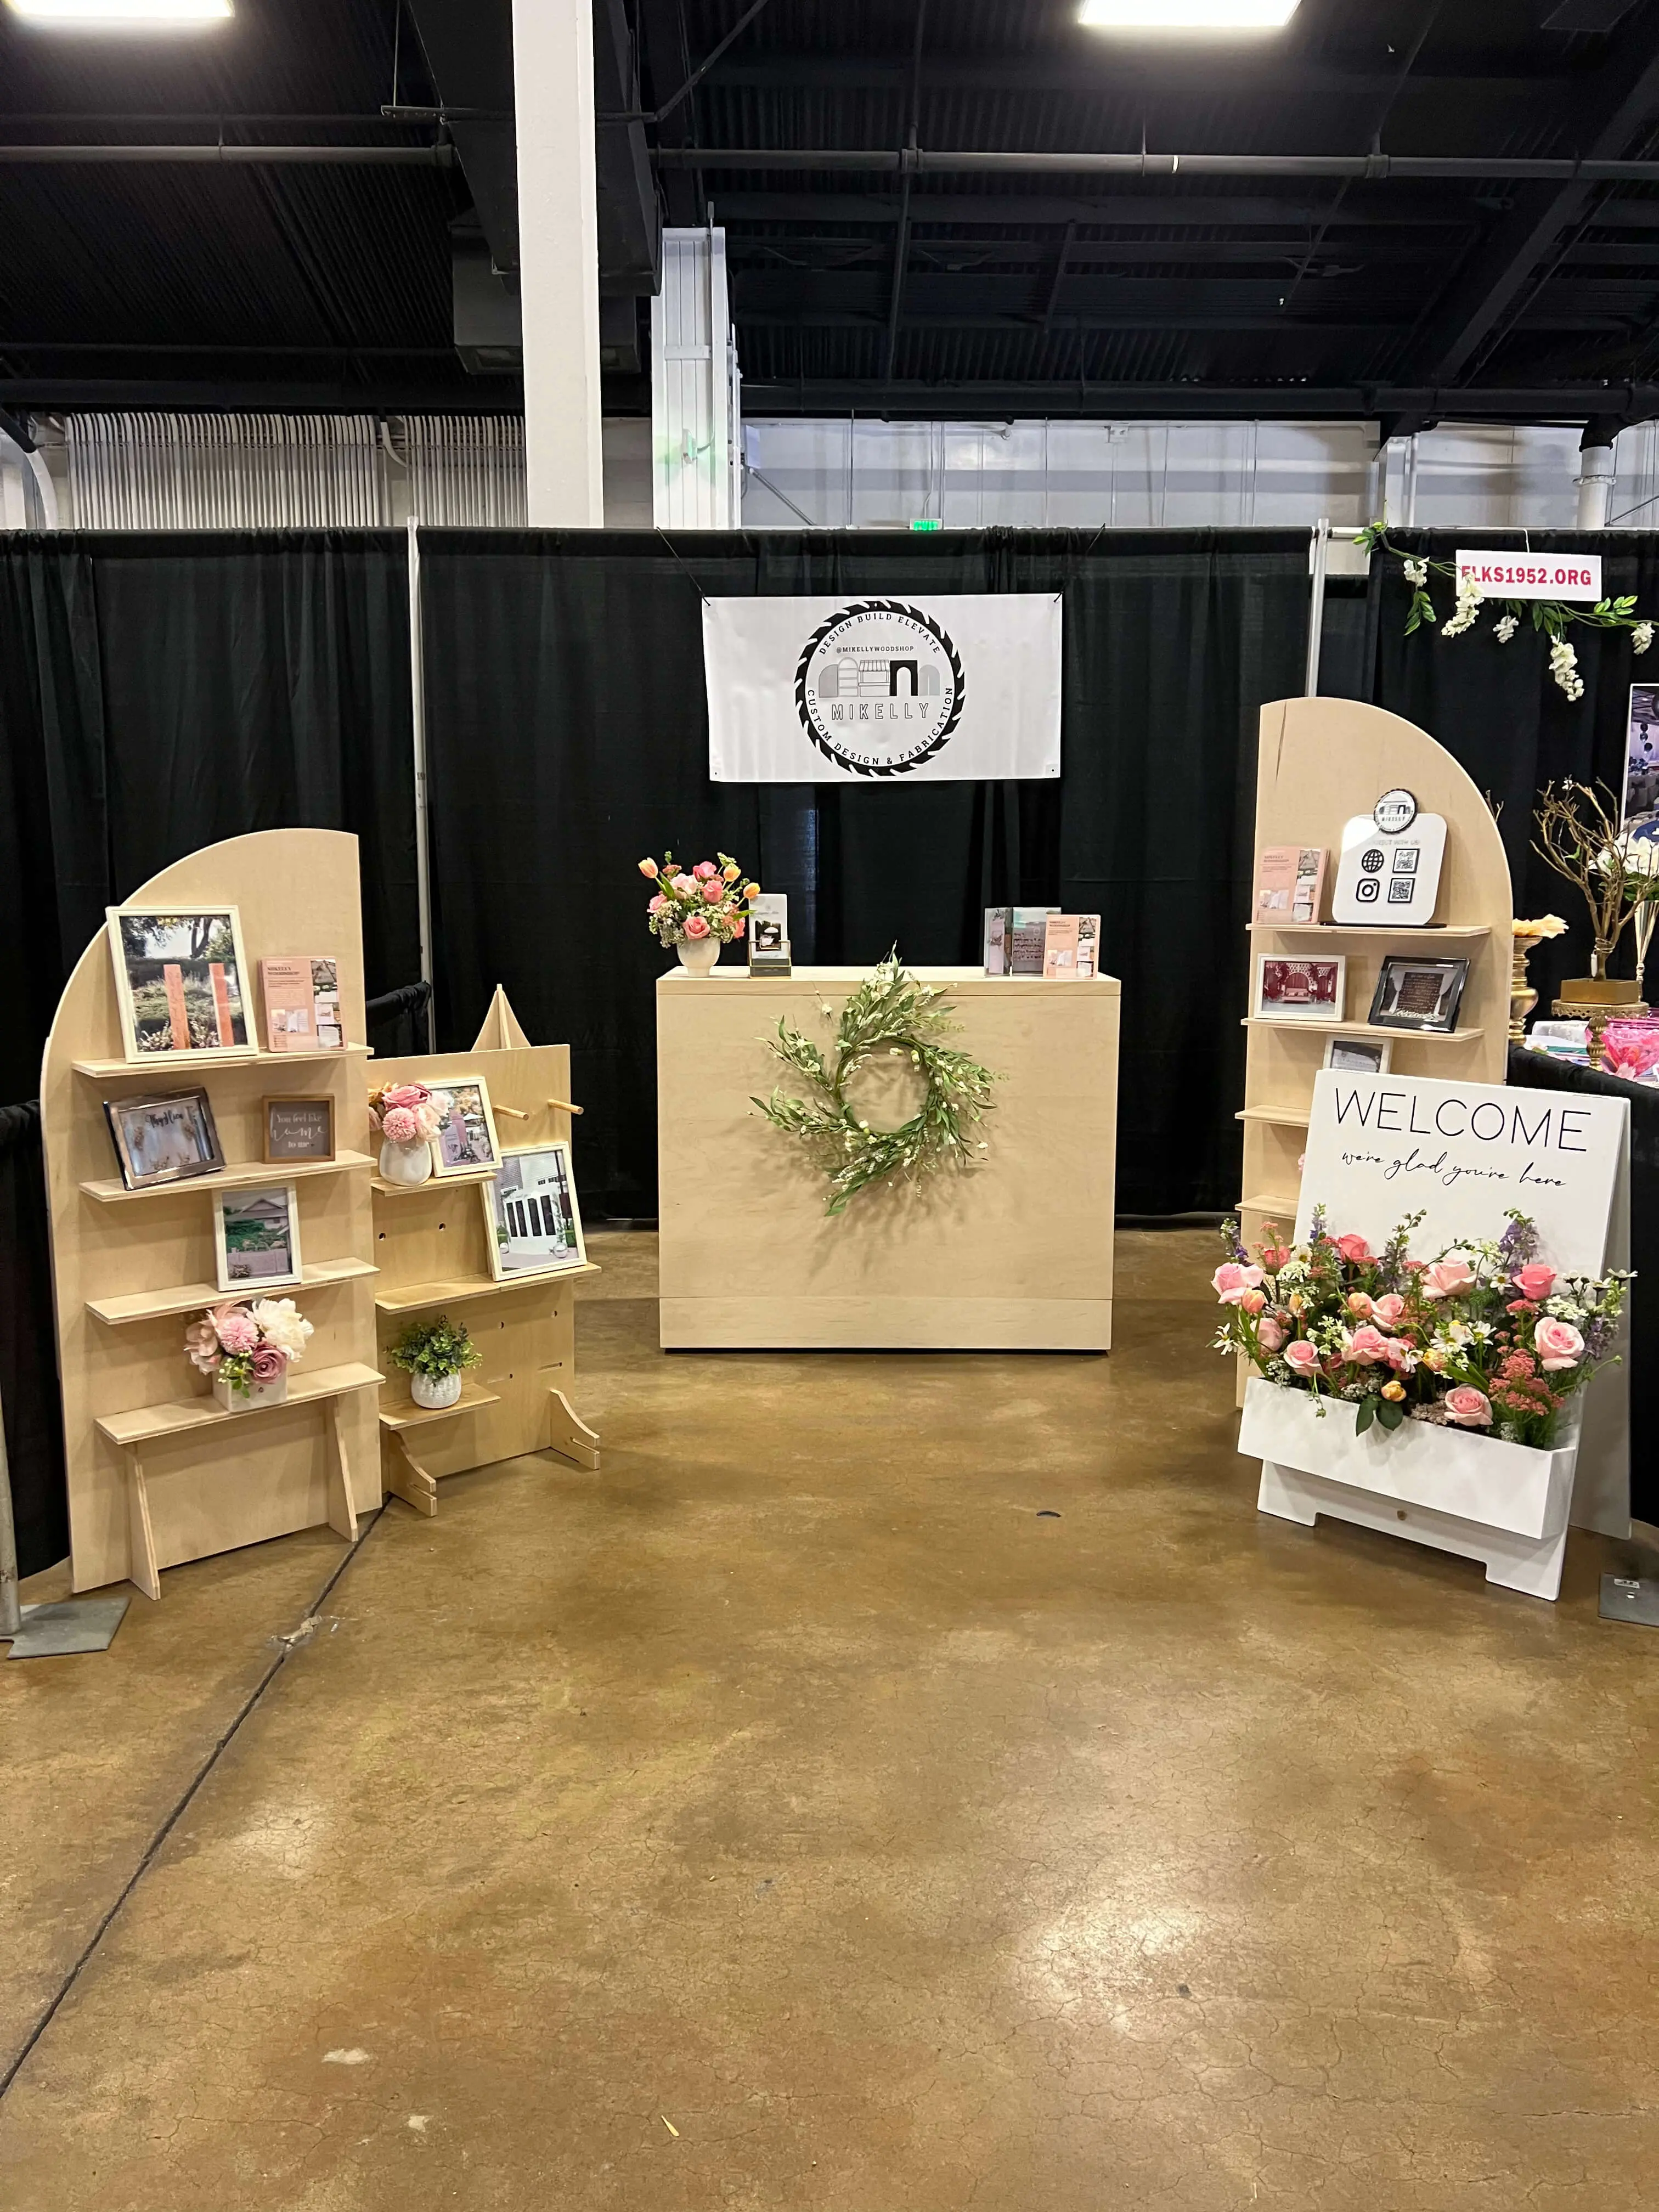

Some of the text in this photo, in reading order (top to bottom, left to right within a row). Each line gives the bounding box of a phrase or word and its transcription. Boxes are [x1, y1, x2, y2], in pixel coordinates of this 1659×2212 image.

[819, 613, 940, 654] DESIGN BUILD ELEVATE
[808, 690, 832, 741] CUSTOM
[834, 743, 879, 765] DESIGN
[899, 688, 953, 761] FABRICATION
[832, 703, 928, 720] MIKELLY
[276, 1114, 290, 1122] You
[1336, 1088, 1591, 1152] WELCOME
[1342, 1148, 1566, 1186] we're glad you're here
